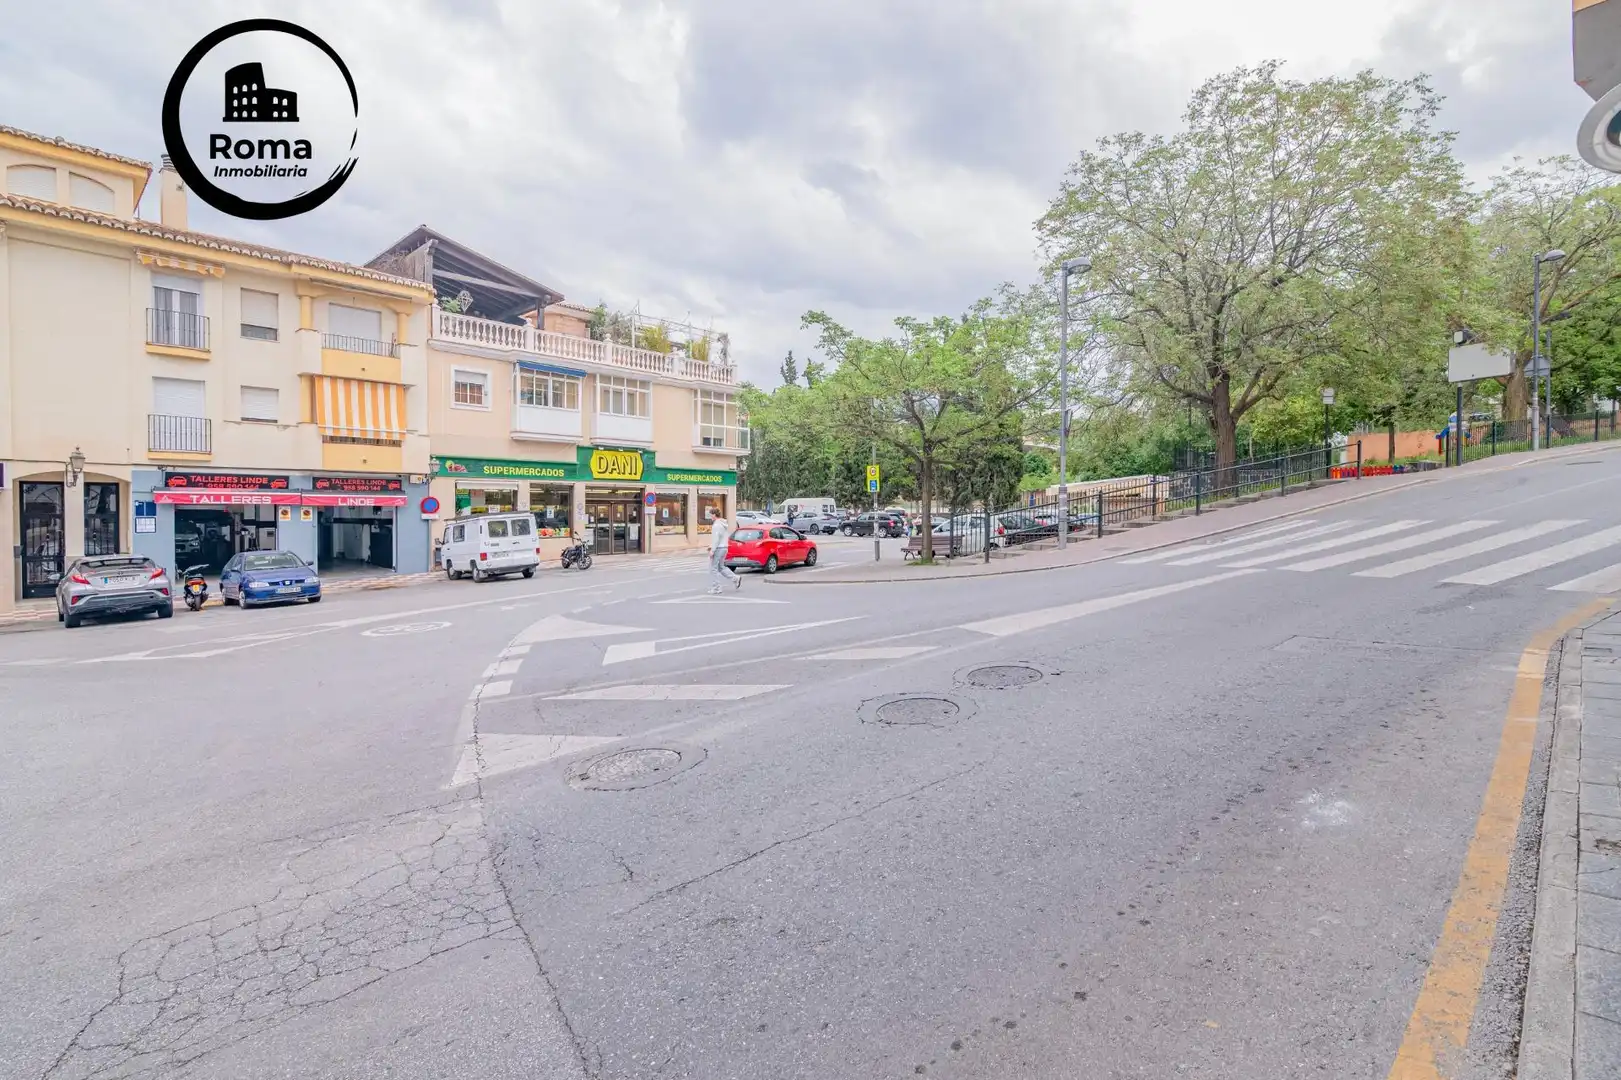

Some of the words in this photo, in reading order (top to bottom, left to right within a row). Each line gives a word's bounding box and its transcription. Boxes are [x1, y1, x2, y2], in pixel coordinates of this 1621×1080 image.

[596, 454, 638, 476] DANI
[483, 465, 565, 477] SUPERMERCADOS
[189, 475, 238, 483] TALLERES
[240, 476, 269, 485] LINDE
[666, 473, 722, 483] SUPERMERCADOS
[189, 494, 272, 505] TALLERES
[338, 497, 376, 506] LINDE
